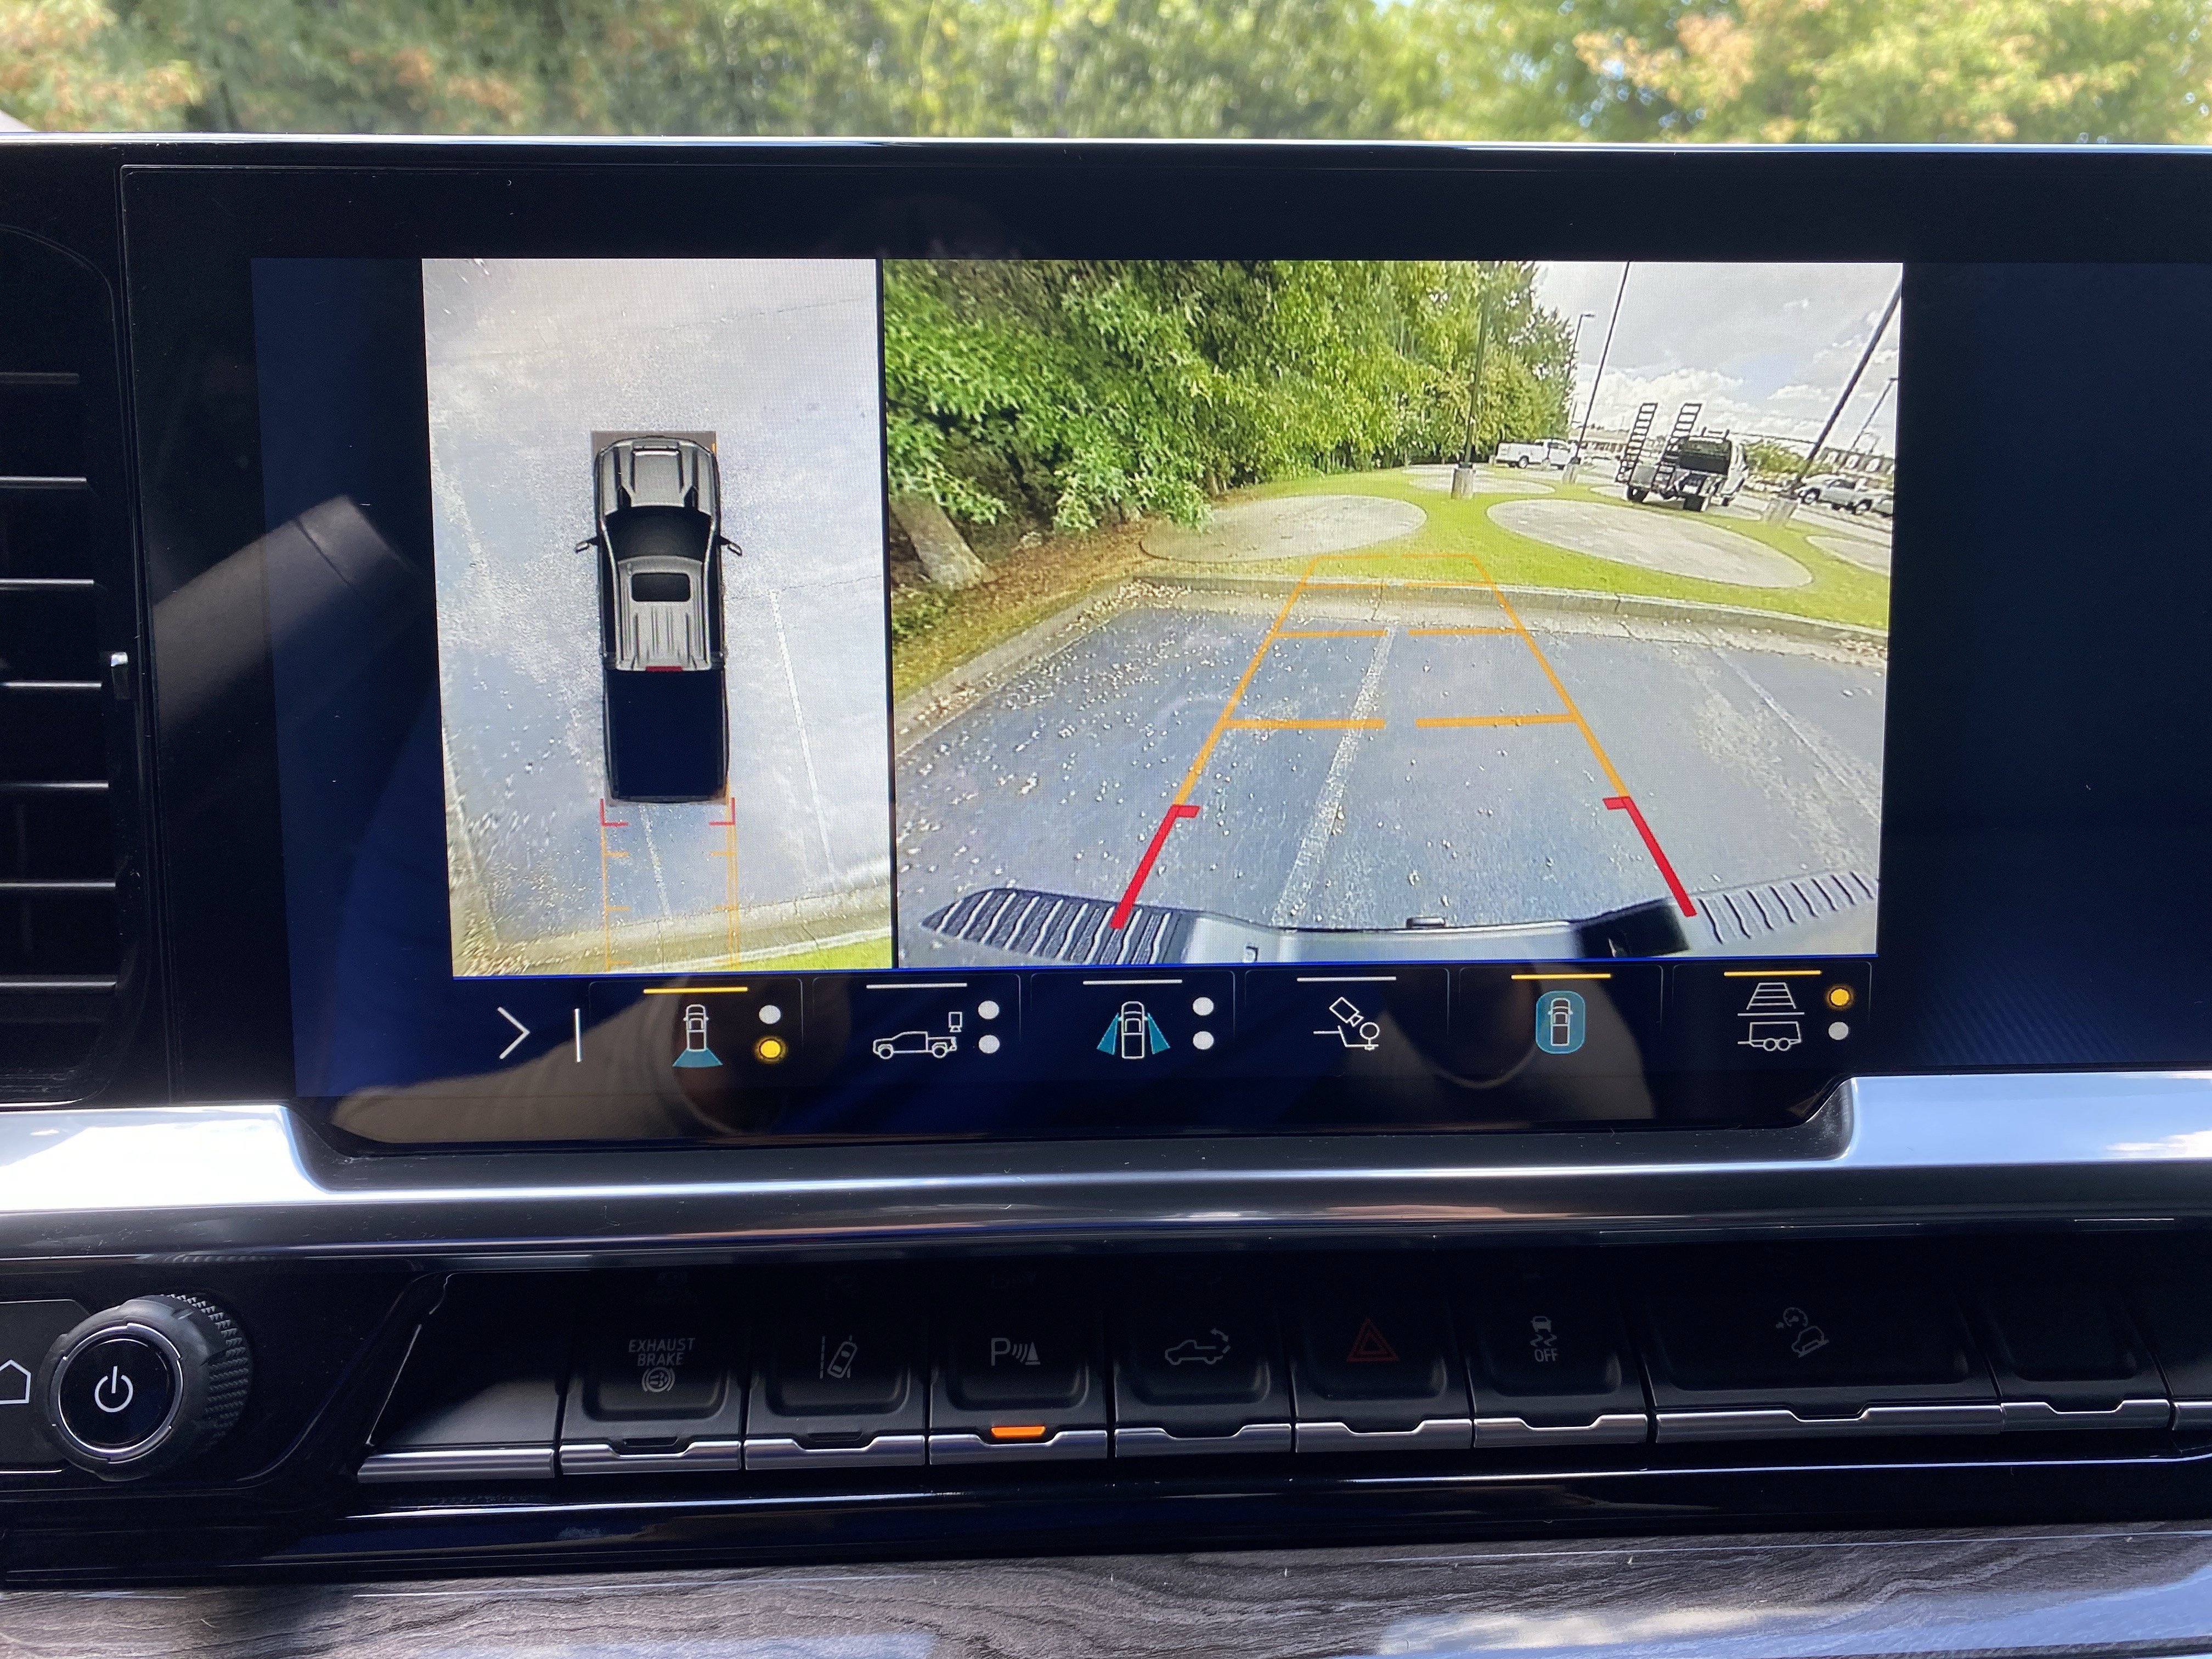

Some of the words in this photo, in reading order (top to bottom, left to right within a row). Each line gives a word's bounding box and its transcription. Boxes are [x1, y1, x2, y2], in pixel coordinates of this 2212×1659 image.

[628, 1338, 696, 1352] EXHAUST
[637, 1352, 685, 1367] BRAKE
[1534, 1348, 1559, 1363] OFF
